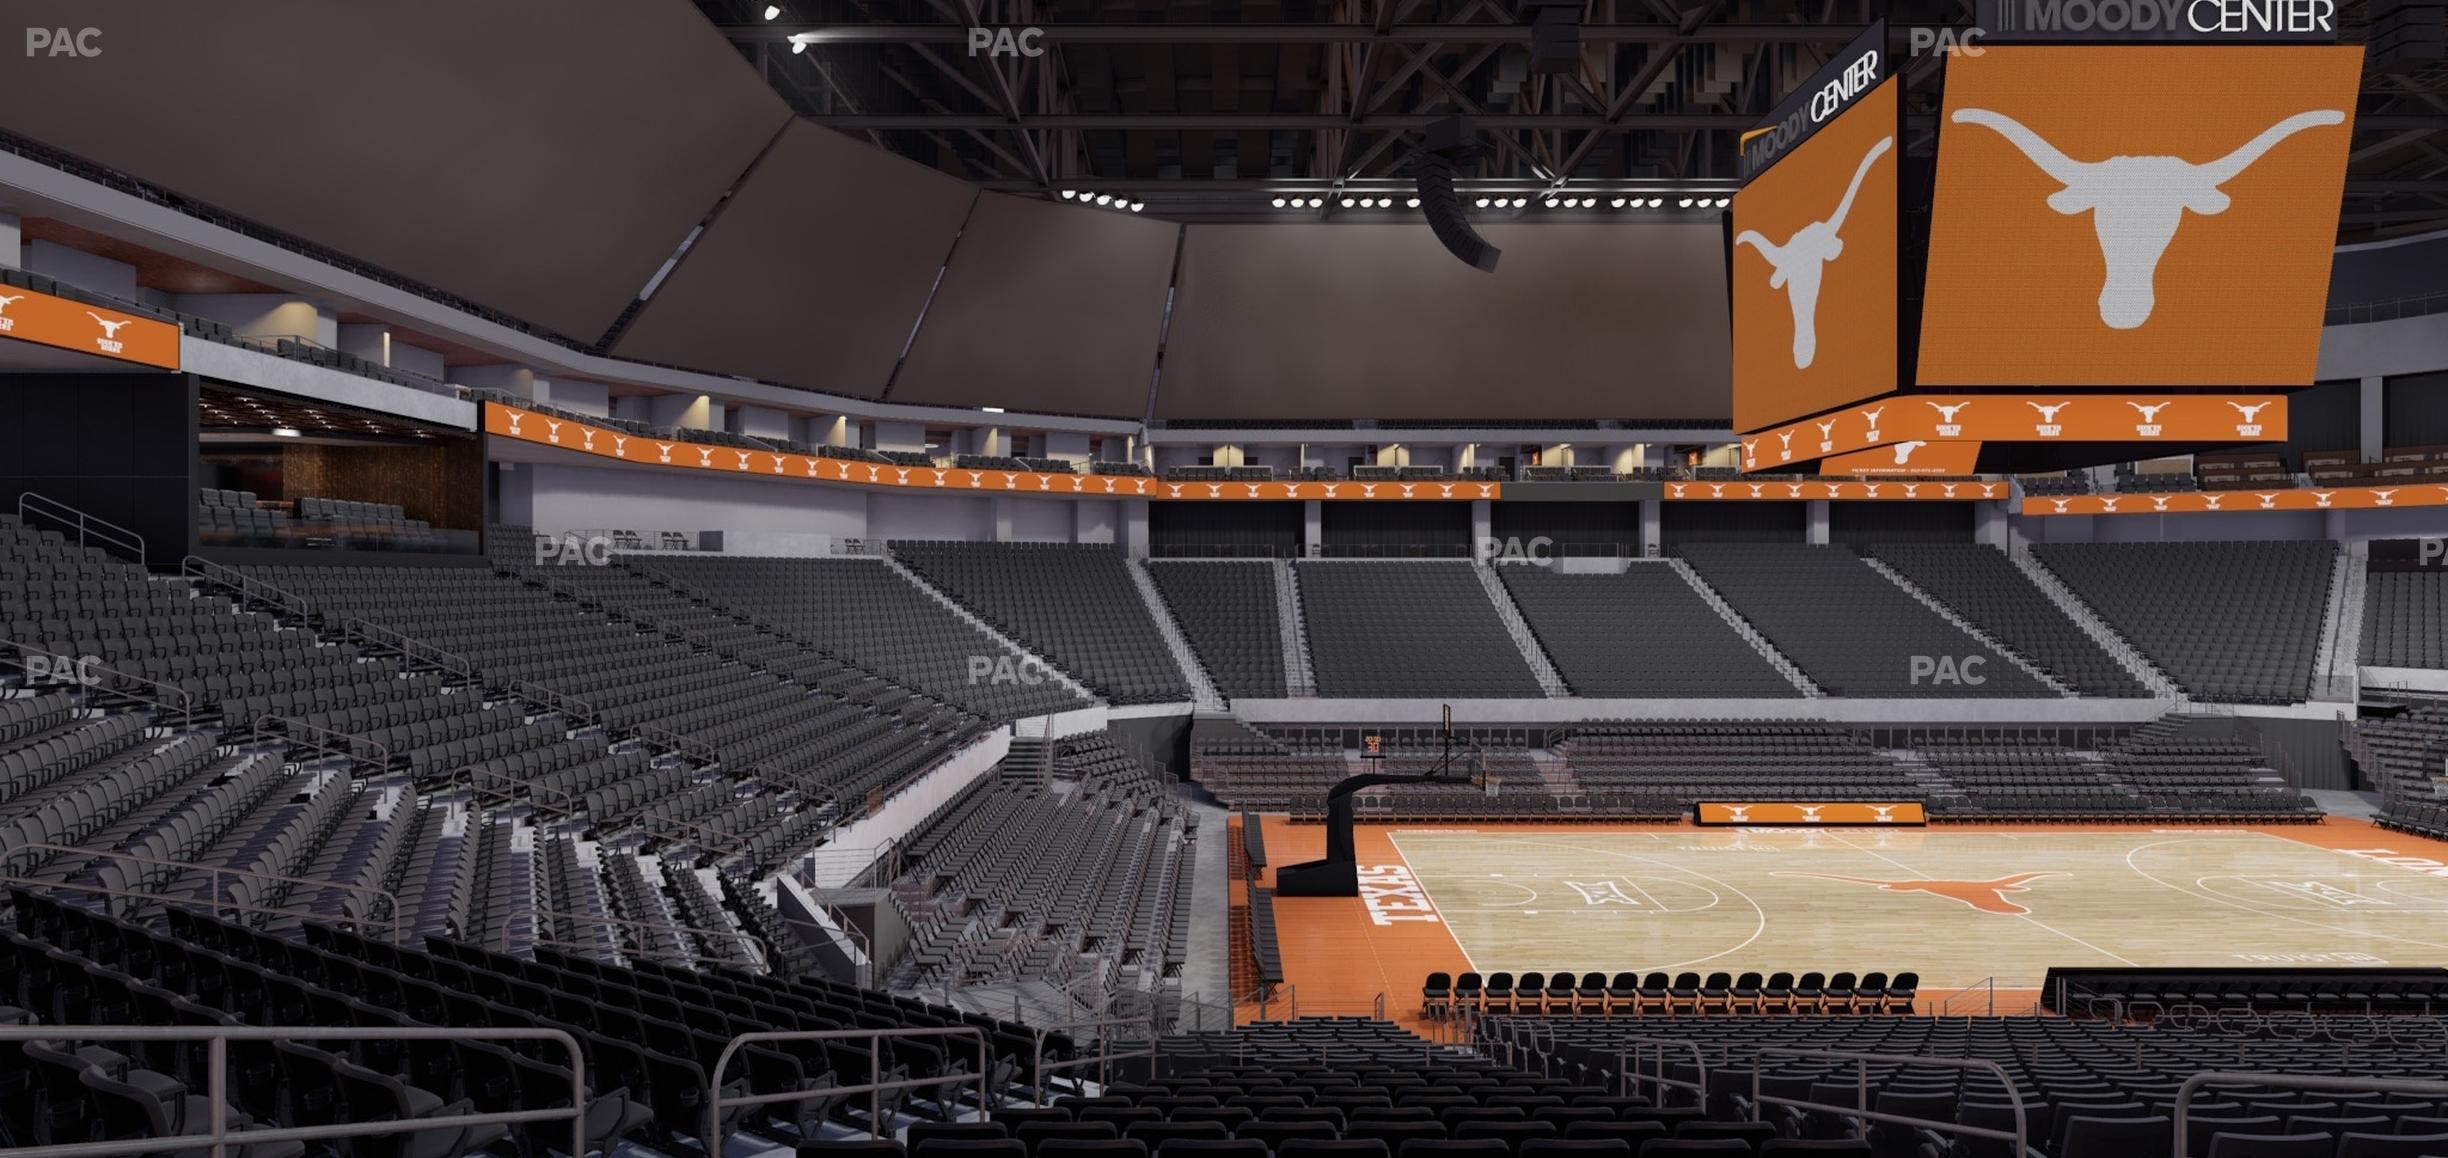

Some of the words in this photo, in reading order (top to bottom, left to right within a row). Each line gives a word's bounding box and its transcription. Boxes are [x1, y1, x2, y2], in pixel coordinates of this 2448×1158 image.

[2025, 0, 2185, 32] MOODY
[2187, 0, 2334, 32] CENTER
[1752, 102, 1810, 170] MOODY
[1810, 49, 1878, 123] CENTER
[1357, 864, 1440, 926] TEXAS
